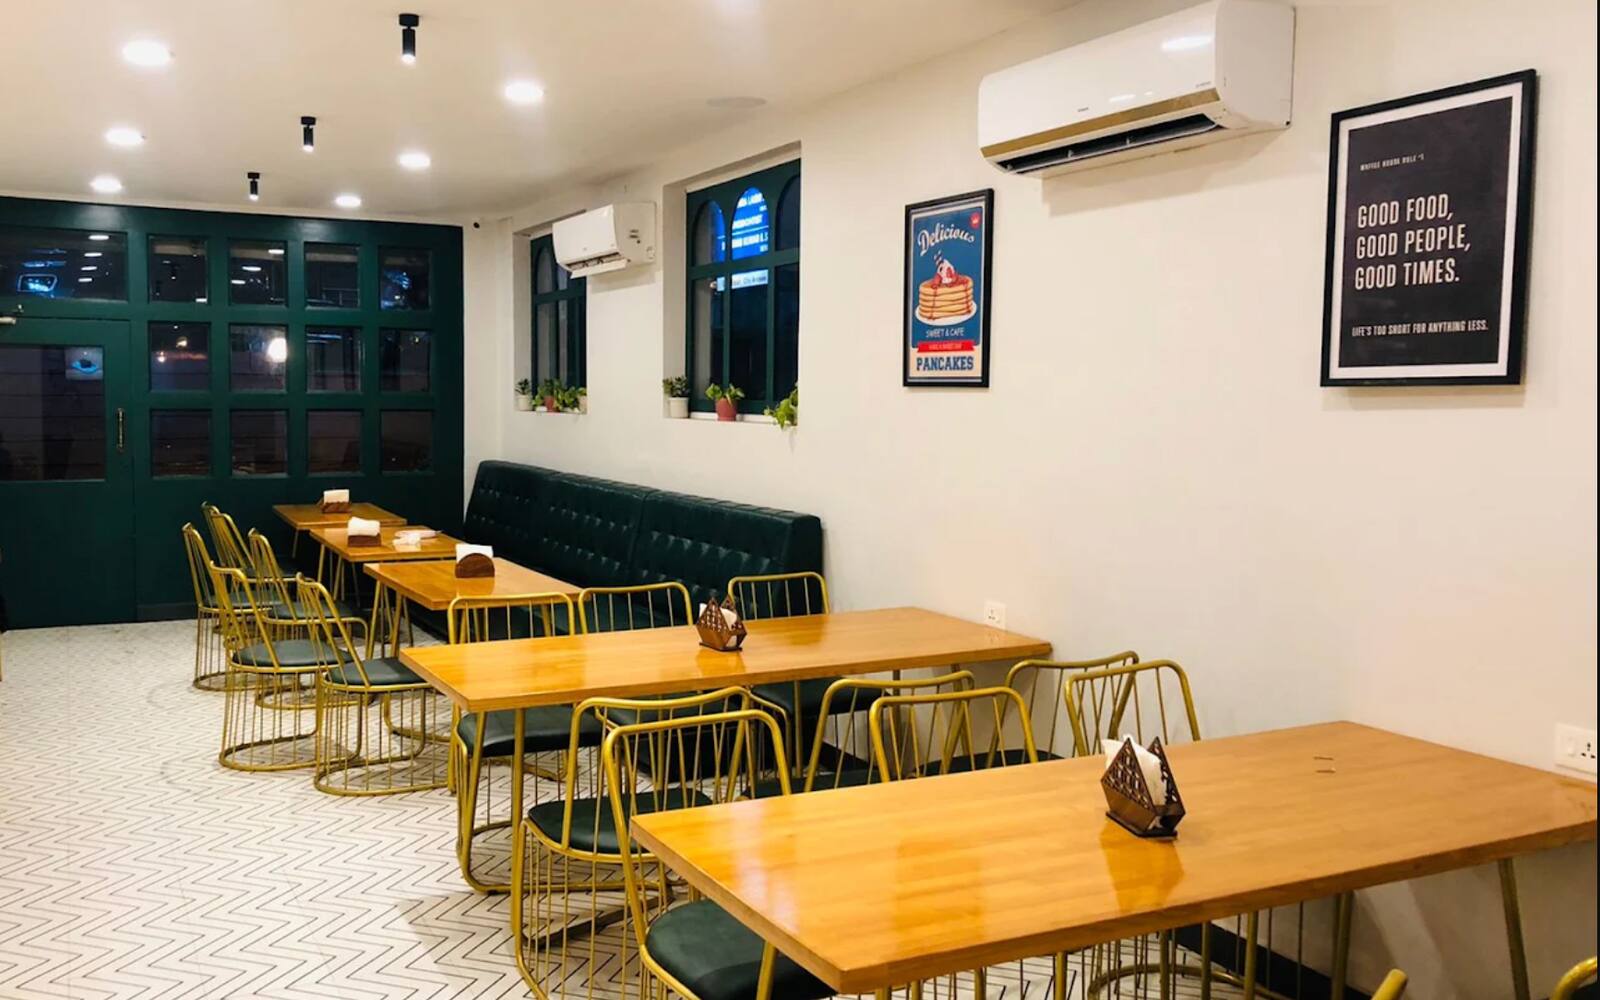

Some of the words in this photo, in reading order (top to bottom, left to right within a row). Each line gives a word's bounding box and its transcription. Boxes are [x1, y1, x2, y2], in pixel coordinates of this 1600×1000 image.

[1357, 201, 1400, 229] GOOD
[1406, 193, 1454, 222] FOOD,
[917, 222, 975, 257] Delicious
[1356, 232, 1398, 260] GOOD
[1404, 223, 1471, 254] PEOPLE,
[1354, 264, 1397, 291] GOOD
[1403, 258, 1460, 286] TIMES.
[1373, 325, 1387, 336] TOO
[1387, 323, 1411, 335] SHORT
[1412, 322, 1427, 334] FOR
[1428, 320, 1467, 334] ANYTHING
[1468, 319, 1489, 331] LESS.
[916, 355, 975, 371] PANCAKES
